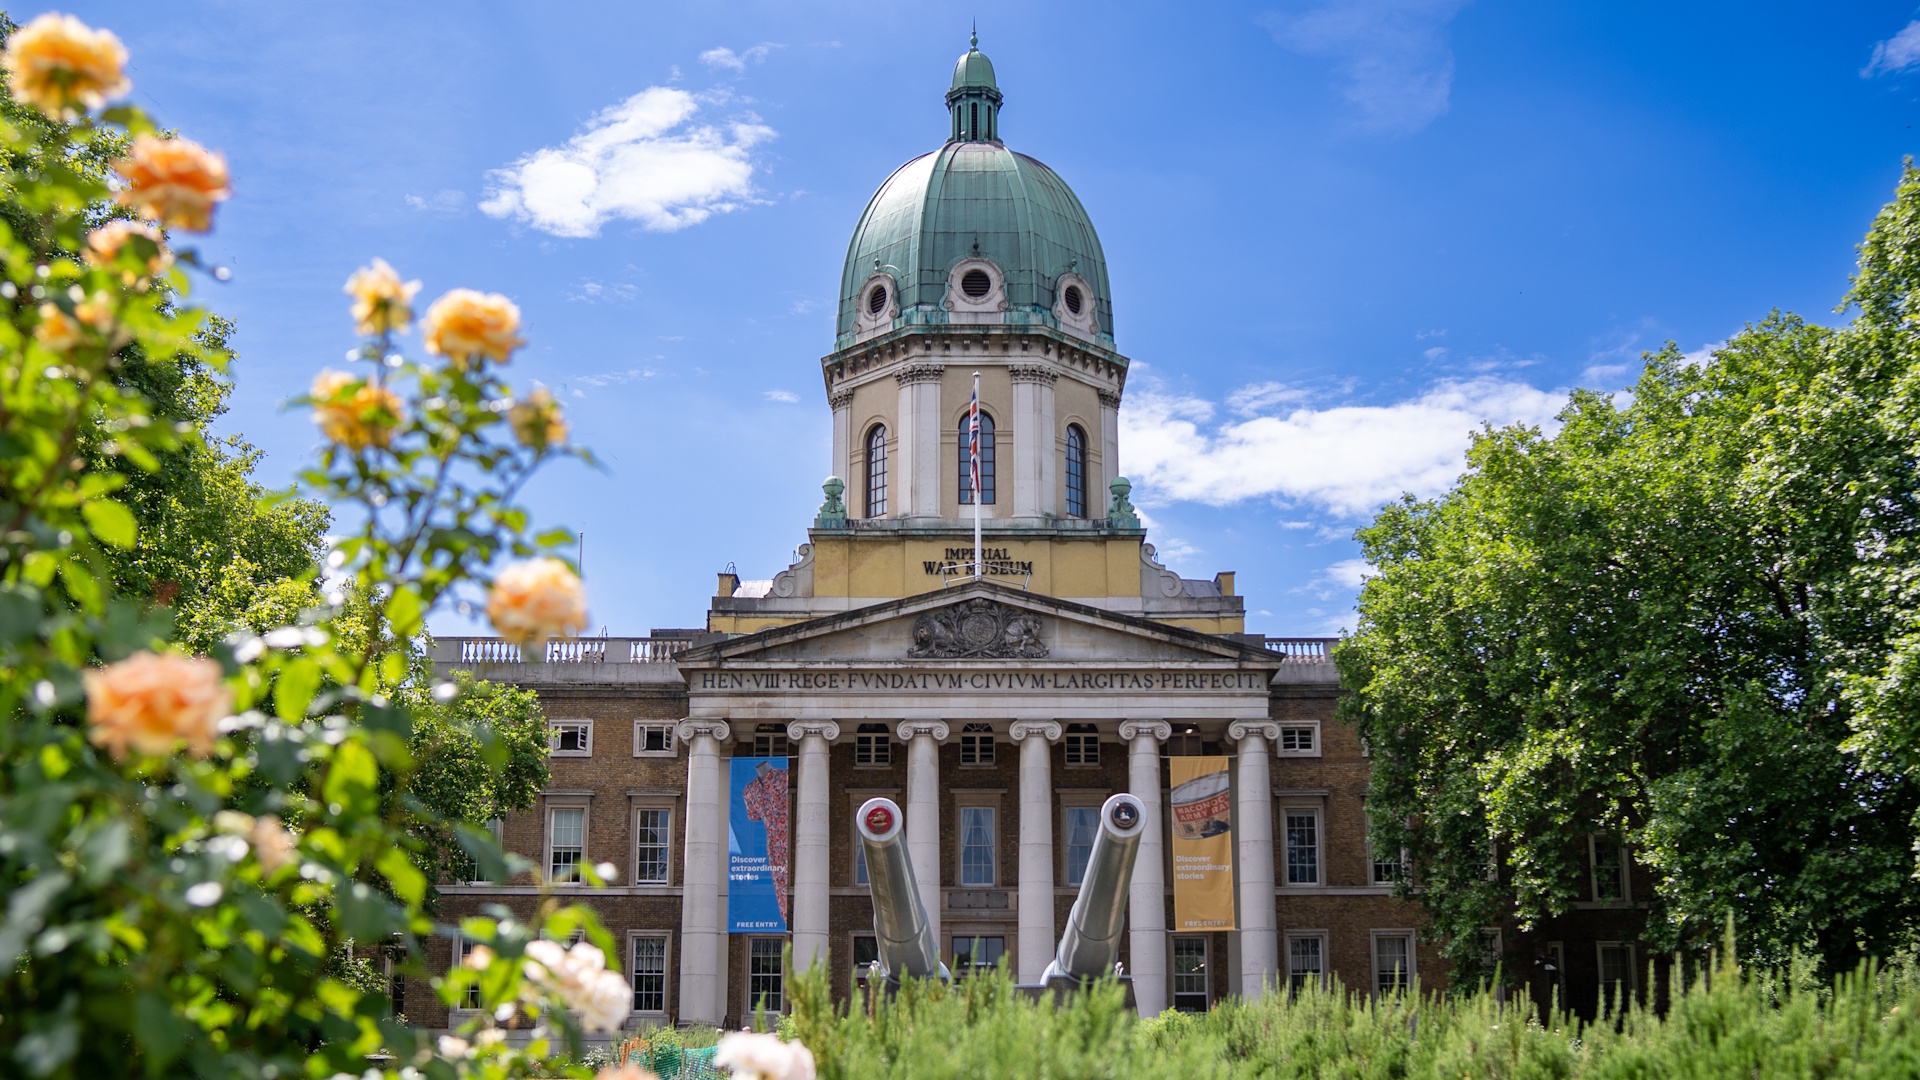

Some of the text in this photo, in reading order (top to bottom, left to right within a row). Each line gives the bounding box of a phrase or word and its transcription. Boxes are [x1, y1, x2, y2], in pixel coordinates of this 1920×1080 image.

[923, 561, 958, 575] WAR
[702, 673, 743, 689] HEN
[752, 673, 780, 689] VIII
[788, 673, 839, 689] REGE
[848, 673, 962, 689] FVNDATVM
[970, 673, 1046, 689] CIVIVM
[1053, 673, 1154, 689] LARGITAS
[1180, 809, 1208, 821] ARMY
[731, 864, 785, 873] extraordinary
[1176, 864, 1230, 872] extraordinary
[1177, 872, 1205, 880] stories
